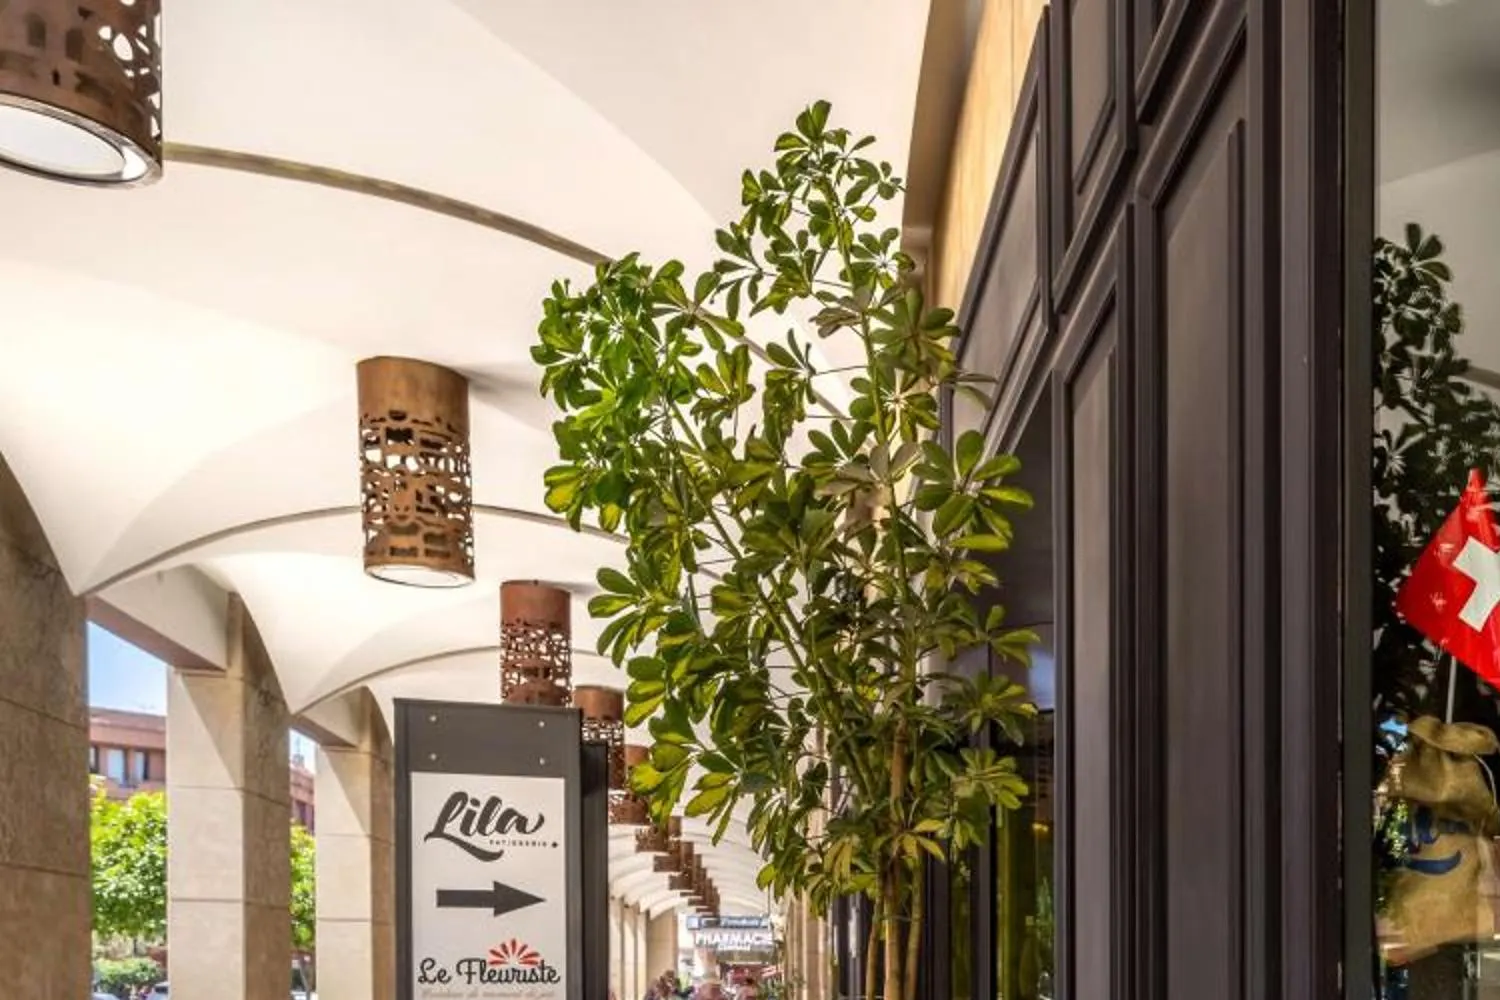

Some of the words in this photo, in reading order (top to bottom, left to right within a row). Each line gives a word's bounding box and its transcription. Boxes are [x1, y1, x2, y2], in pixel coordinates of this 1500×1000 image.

[424, 791, 545, 862] Lila
[418, 957, 451, 984] Le
[456, 957, 561, 985] Fleuriste
